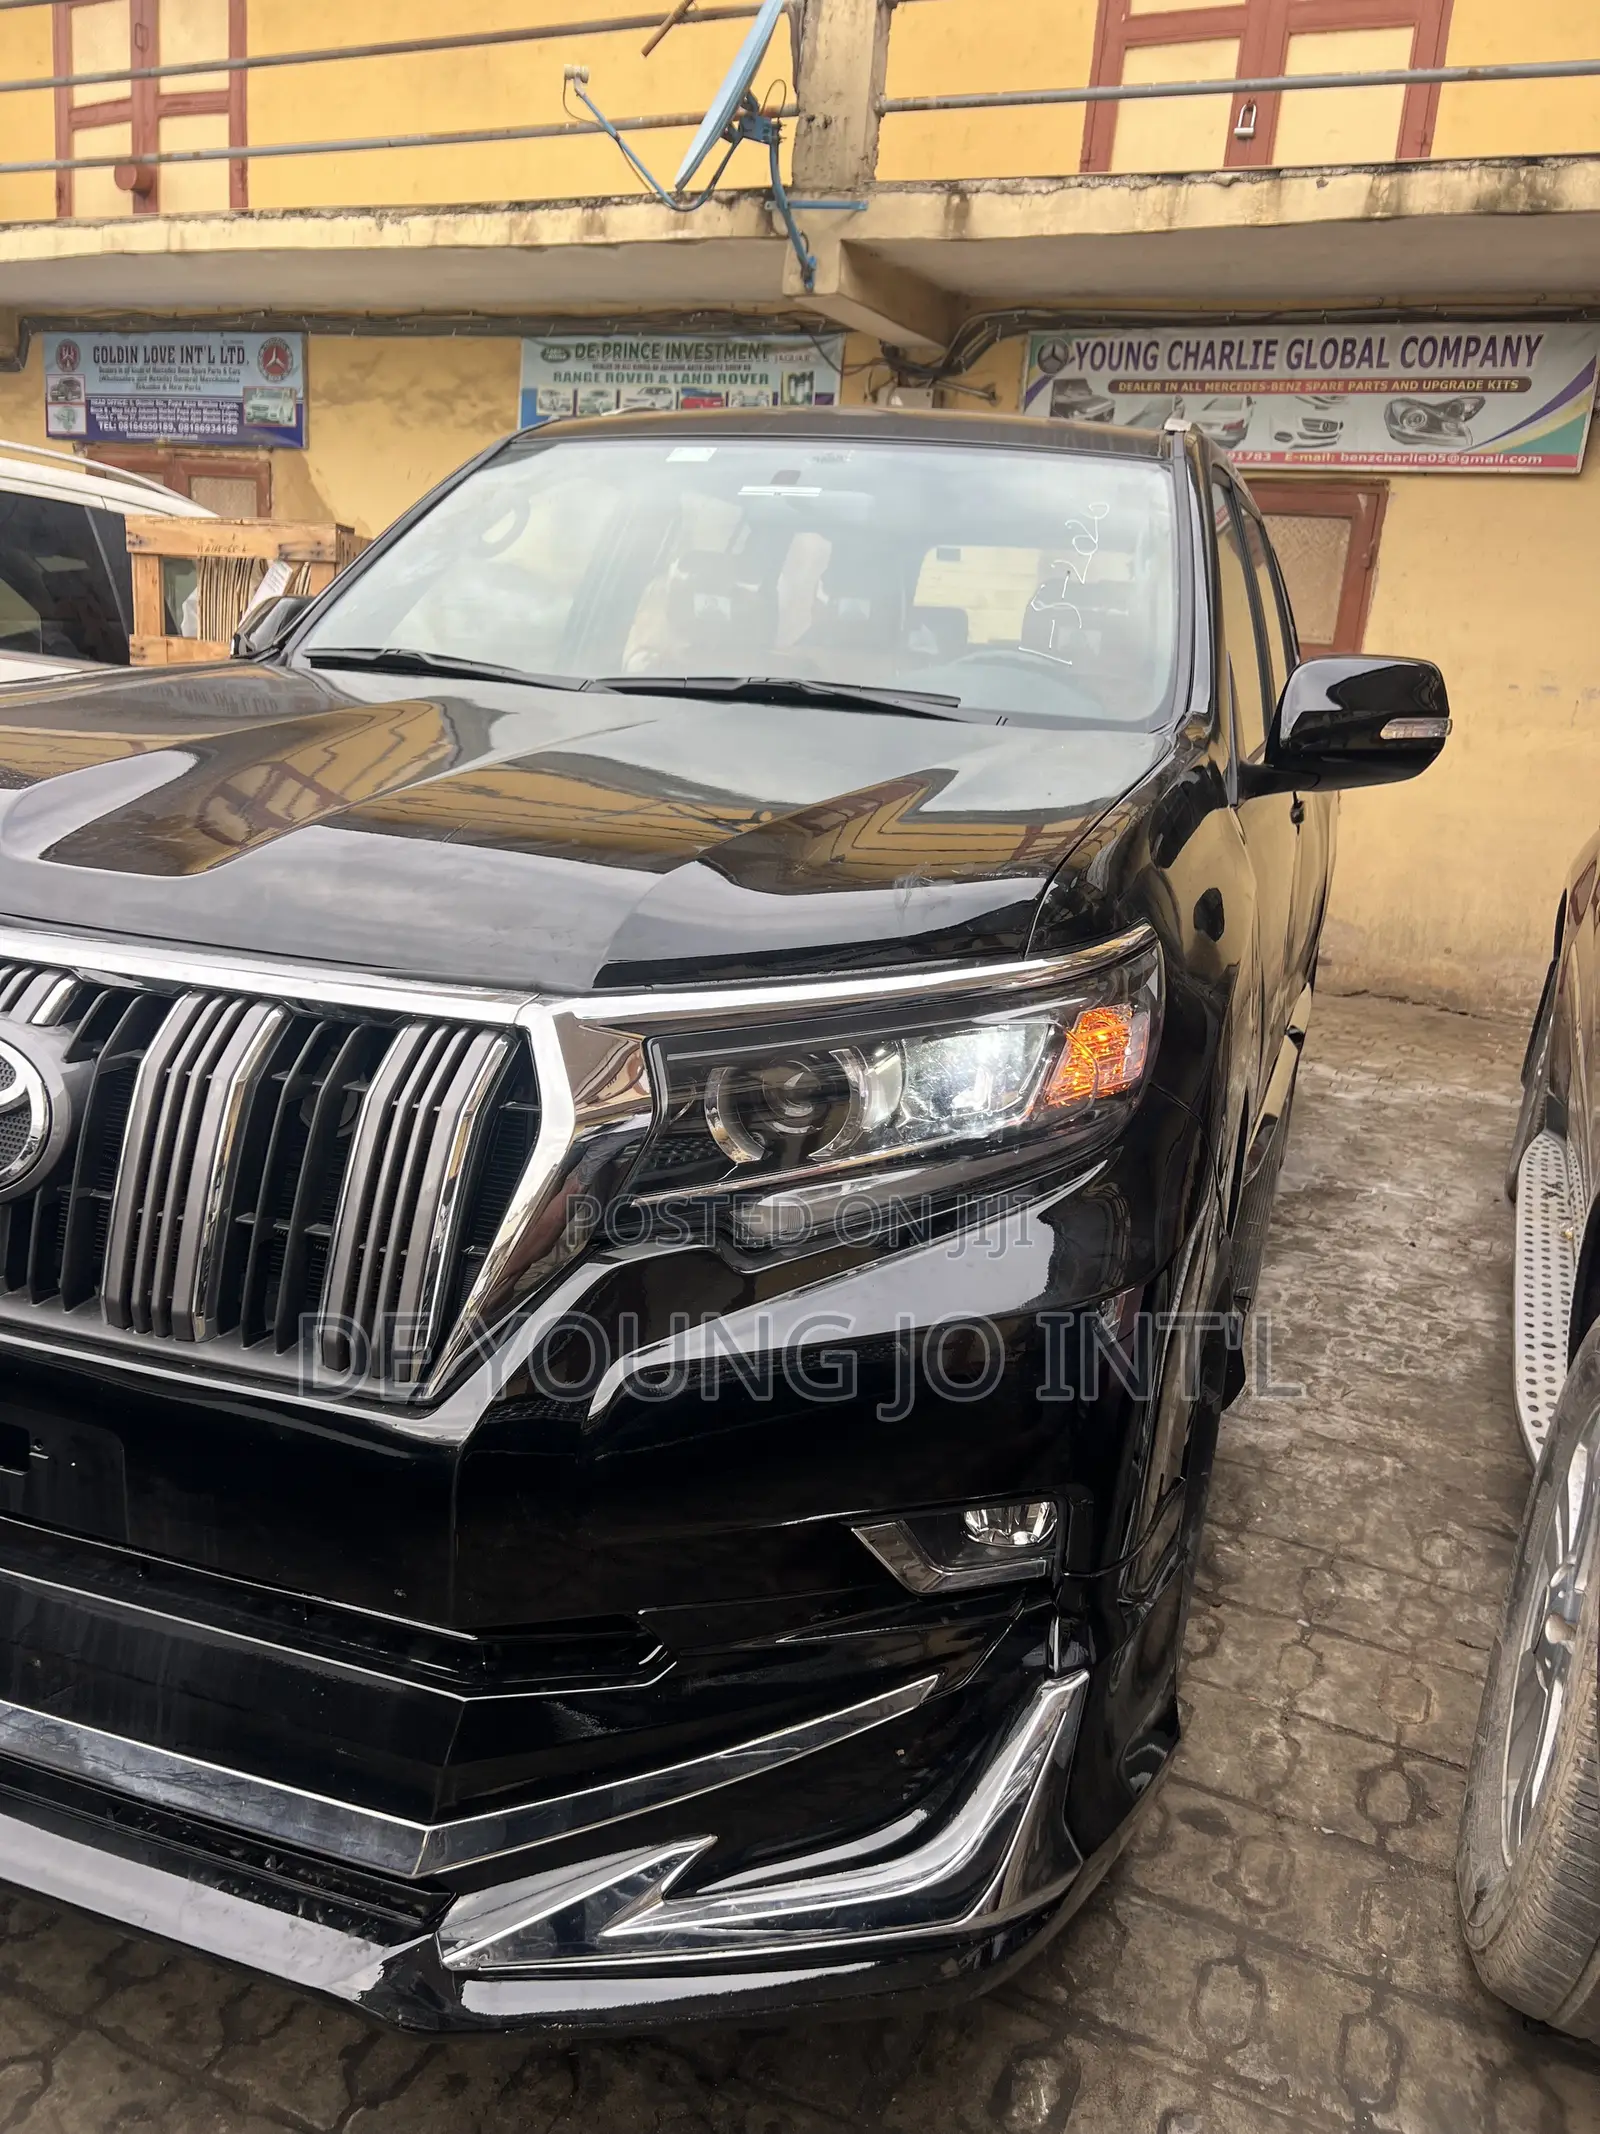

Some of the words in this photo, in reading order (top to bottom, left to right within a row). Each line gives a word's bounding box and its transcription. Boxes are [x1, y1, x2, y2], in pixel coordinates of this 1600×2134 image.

[93, 345, 138, 364] GOLDIN
[143, 345, 175, 364] LOVE
[180, 345, 215, 365] INT'L
[665, 342, 771, 362] INVESTMENT
[1075, 340, 1160, 371] YOUNG
[1167, 339, 1279, 371] CHARLIE
[1285, 336, 1391, 370] GLOBAL
[1400, 334, 1545, 369] COMPANY
[553, 371, 600, 383] RANGE
[605, 371, 653, 384] ROVER
[674, 372, 713, 385] LAND
[717, 373, 769, 385] ROVER
[1118, 381, 1161, 393] DEALER
[1164, 381, 1177, 392] IN
[1181, 381, 1202, 392] ALL
[1205, 381, 1301, 393] MERCEDES-BENZ
[1305, 381, 1344, 392] SPARE
[1348, 380, 1388, 392] PARTS
[1391, 380, 1418, 391] AND
[1422, 379, 1484, 391] UPGRADE
[1488, 379, 1519, 391] KITS
